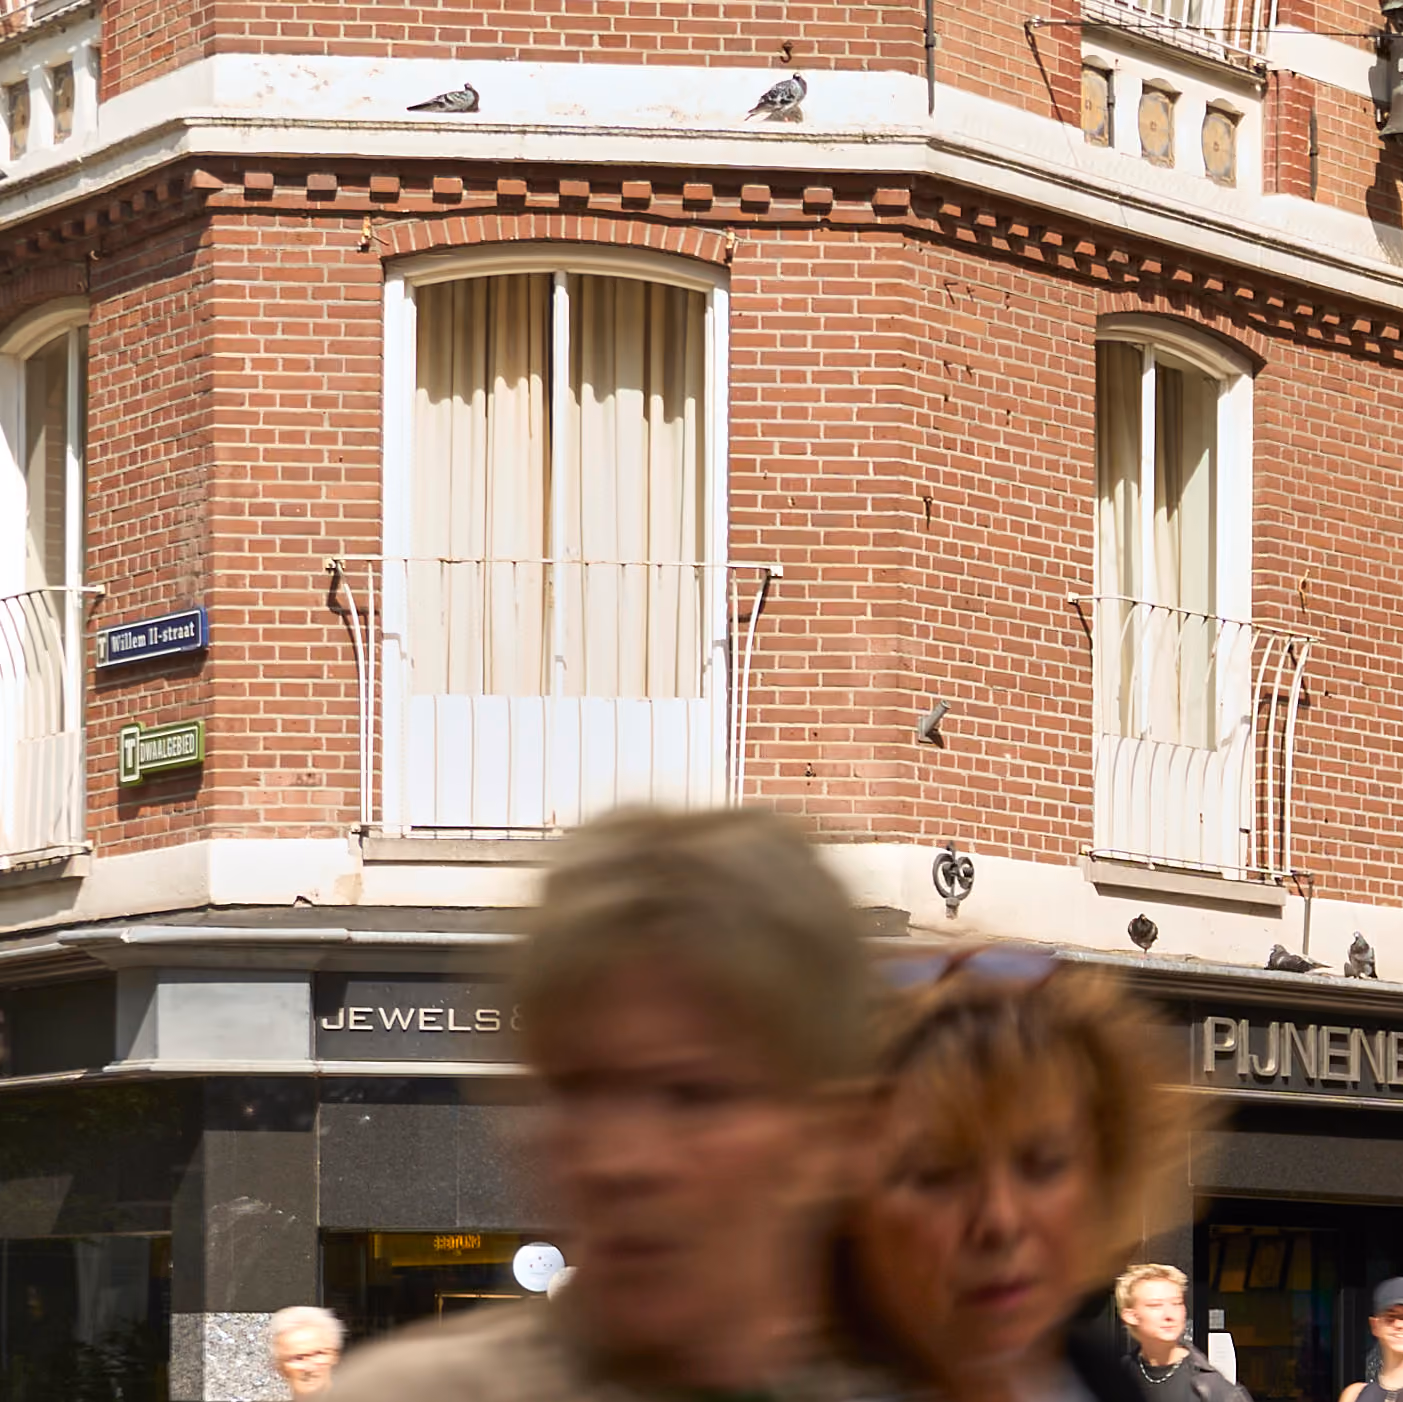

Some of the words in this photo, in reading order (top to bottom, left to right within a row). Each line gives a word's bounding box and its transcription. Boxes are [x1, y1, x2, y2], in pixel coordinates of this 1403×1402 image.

[110, 631, 146, 653] Willem
[149, 621, 195, 645] II-straat
[140, 733, 195, 763] DWAALGEBIED
[321, 1007, 501, 1032] JEWELS
